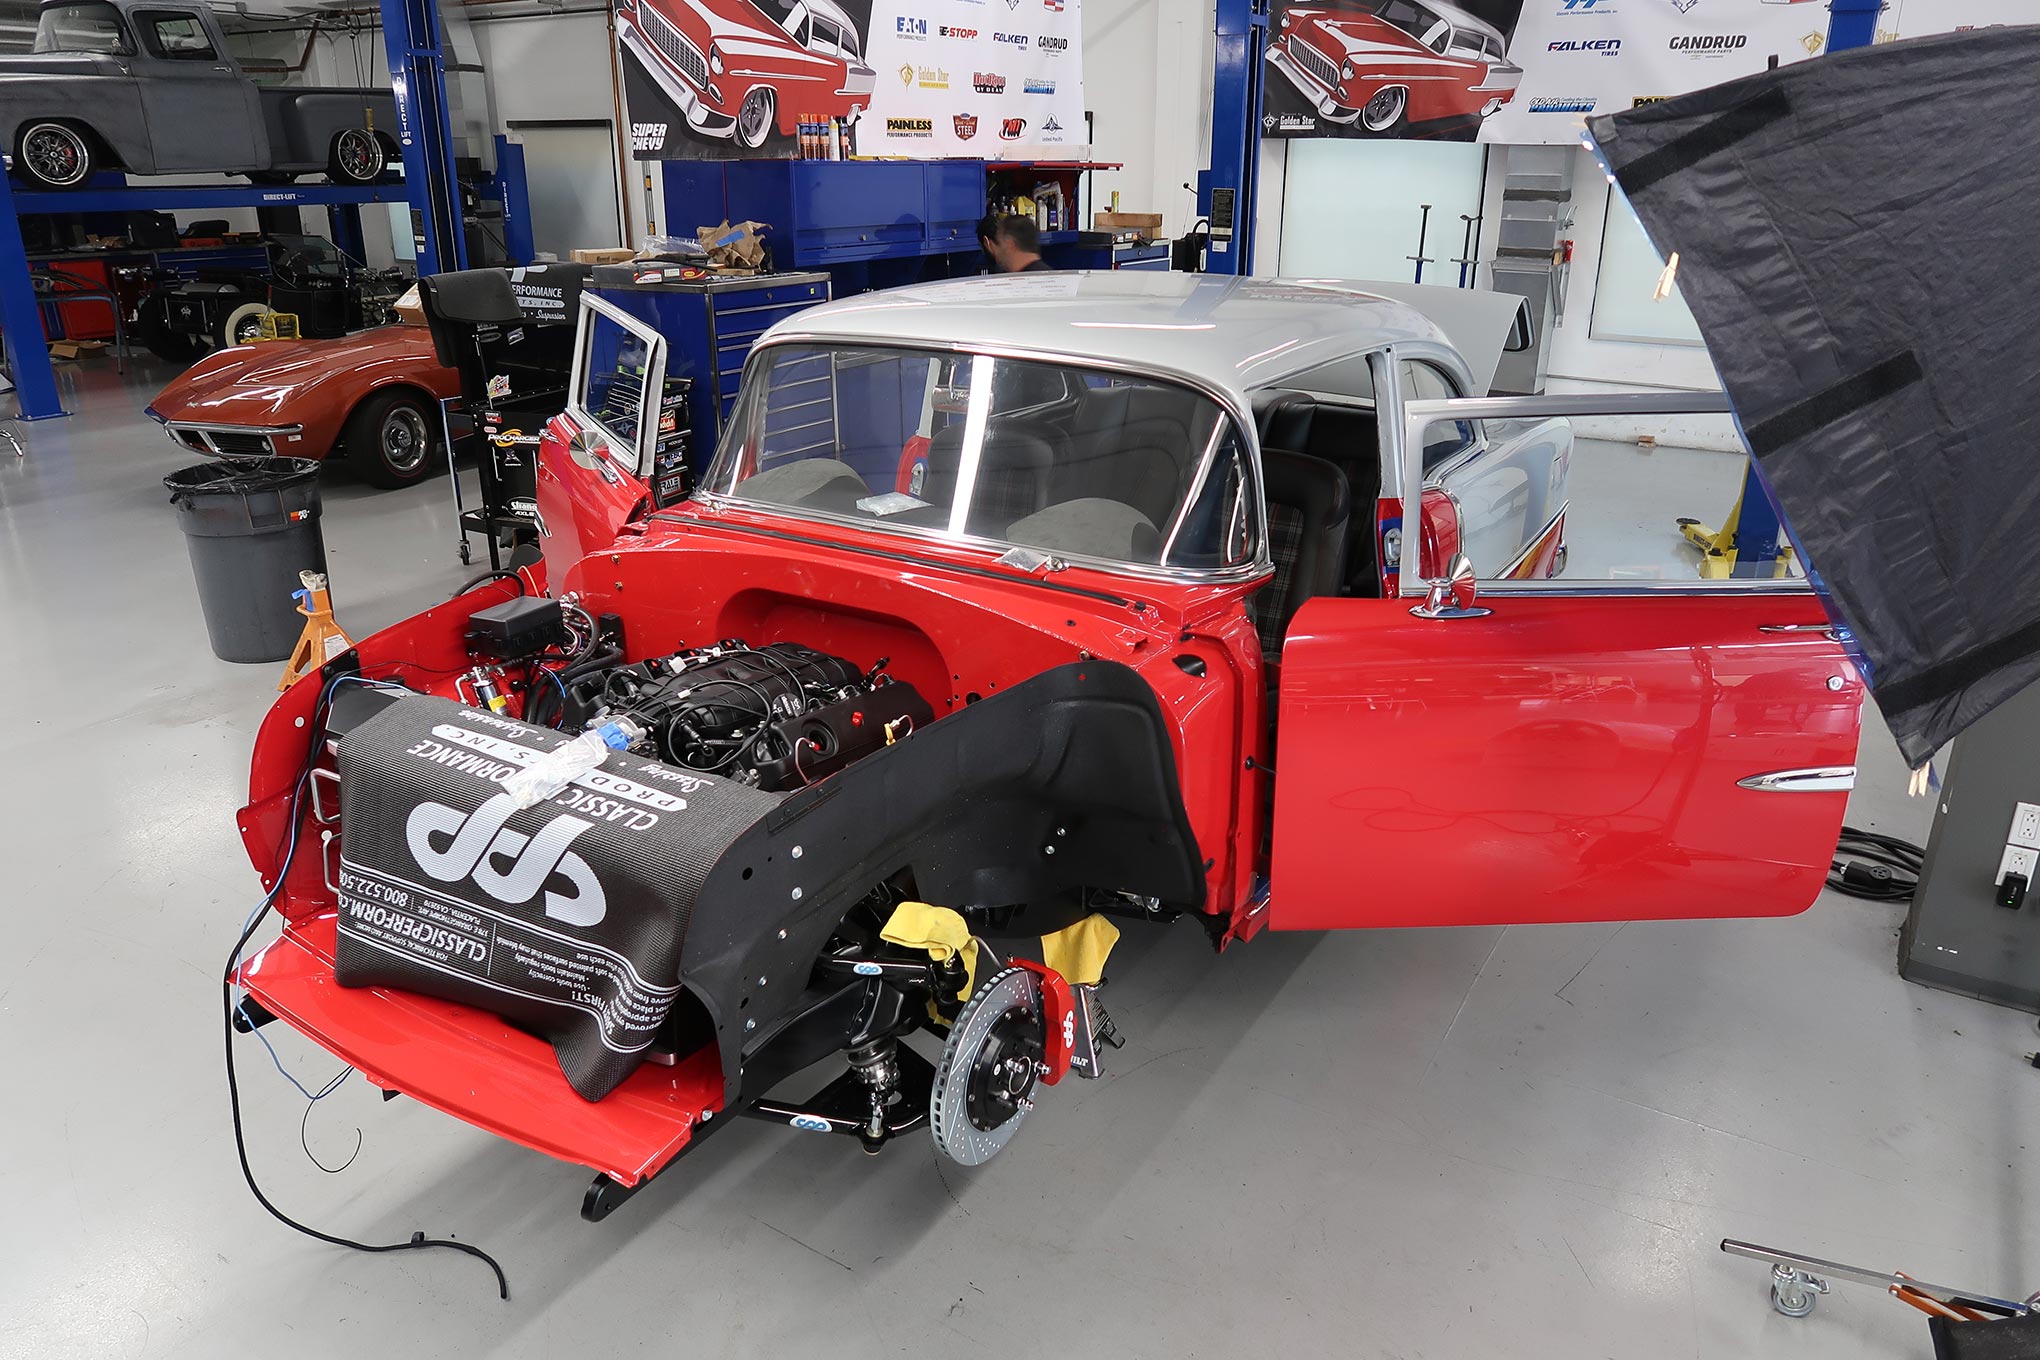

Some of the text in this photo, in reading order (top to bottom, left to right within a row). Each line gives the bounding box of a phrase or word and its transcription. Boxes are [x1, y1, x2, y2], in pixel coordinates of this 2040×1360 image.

[897, 16, 927, 34] EATON
[939, 26, 978, 39] E-STOPP
[993, 32, 1028, 45] FALKEN
[1038, 35, 1068, 50] GANDRUD
[1548, 39, 1621, 51] FALKEN
[1669, 35, 1747, 50] GANDRUD
[918, 65, 949, 82] Golden Star
[396, 76, 409, 131] DRECT
[887, 119, 932, 130] PAINLESS
[1280, 115, 1316, 125] Golden Star
[632, 124, 667, 137] SUPER
[957, 126, 974, 135] STEEL
[632, 137, 664, 150] CHEVY
[512, 285, 562, 298] ERFORMANCE
[446, 726, 493, 750] INC.
[406, 739, 659, 830] CLASSIC ORMANCE
[383, 933, 407, 949] SUPPORT
[407, 942, 437, 958] TECHNICAL
[437, 952, 448, 961] FOR
[531, 949, 543, 959] that
[576, 952, 588, 961] use
[543, 953, 568, 967] surfaces
[590, 955, 606, 964] each
[514, 953, 586, 982] Maintain tools regularly
[568, 960, 595, 973] painted
[595, 967, 608, 976] soft
[528, 969, 587, 991] Use tools correctly
[572, 990, 608, 1012] FIRST!
[633, 1003, 653, 1014] place
